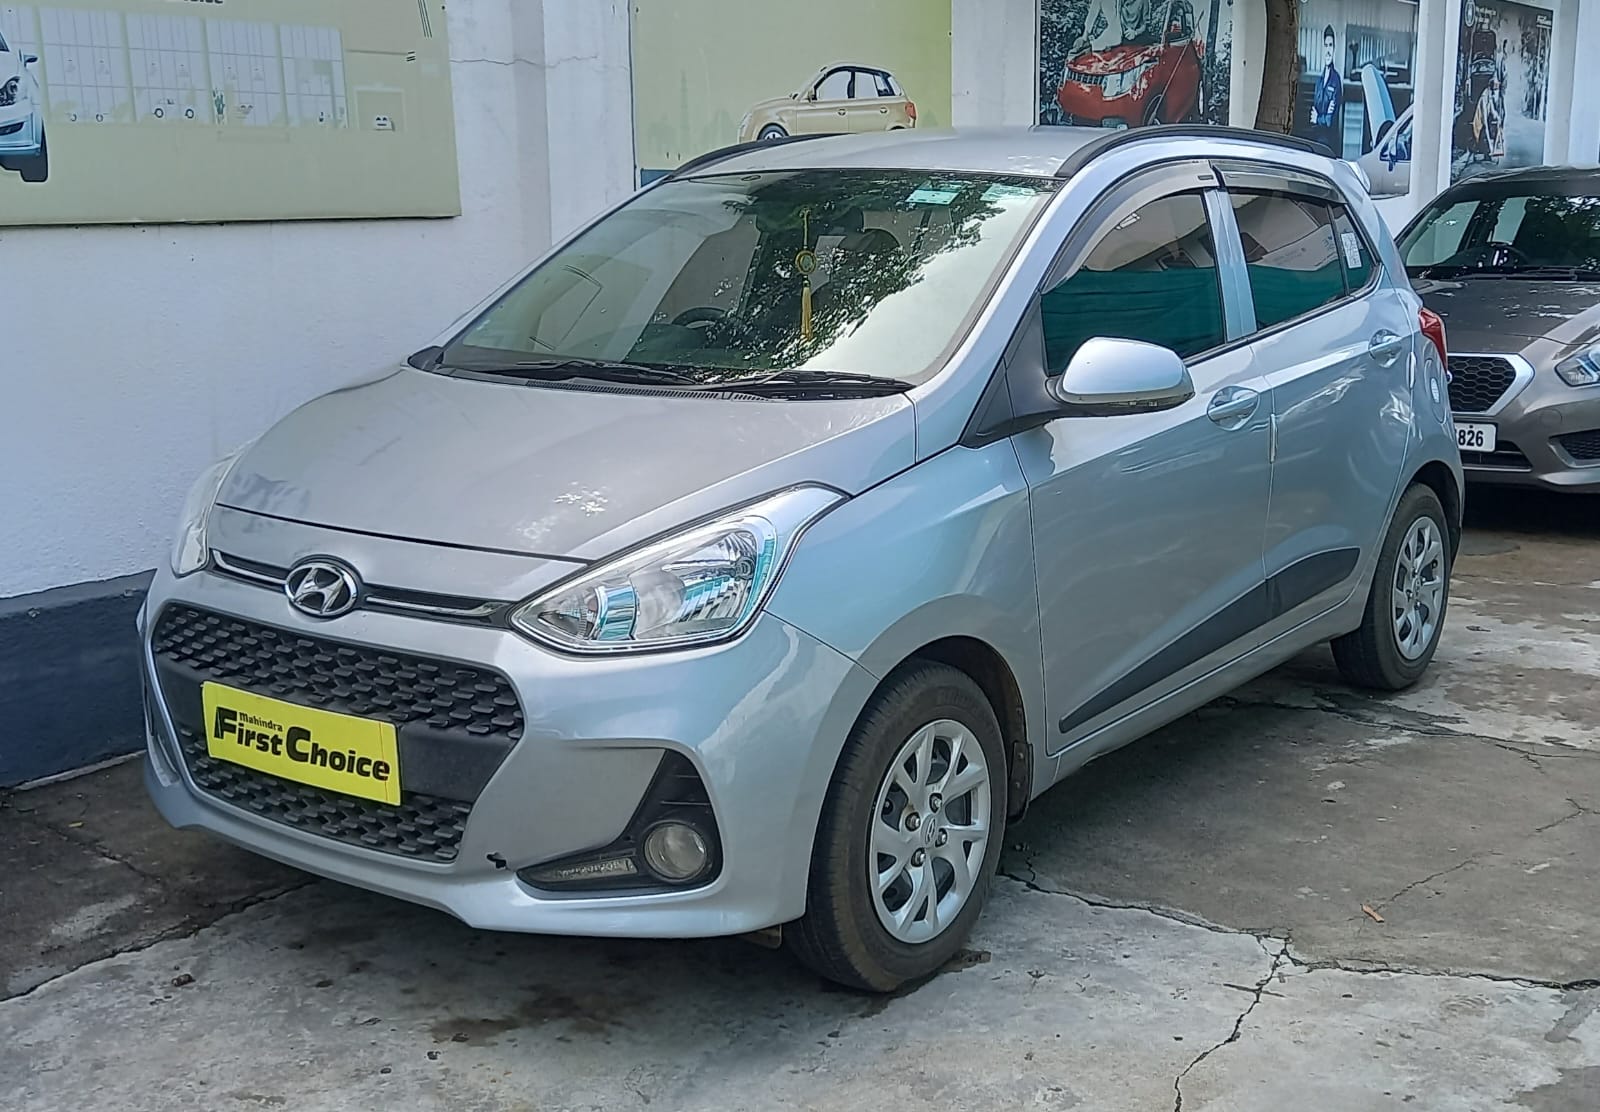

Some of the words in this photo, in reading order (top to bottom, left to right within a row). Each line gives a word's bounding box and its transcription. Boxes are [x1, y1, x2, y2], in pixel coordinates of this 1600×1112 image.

[1456, 429, 1484, 447] 826
[239, 711, 283, 731] Mahindra
[214, 706, 283, 755] First
[286, 726, 390, 781] Choice
